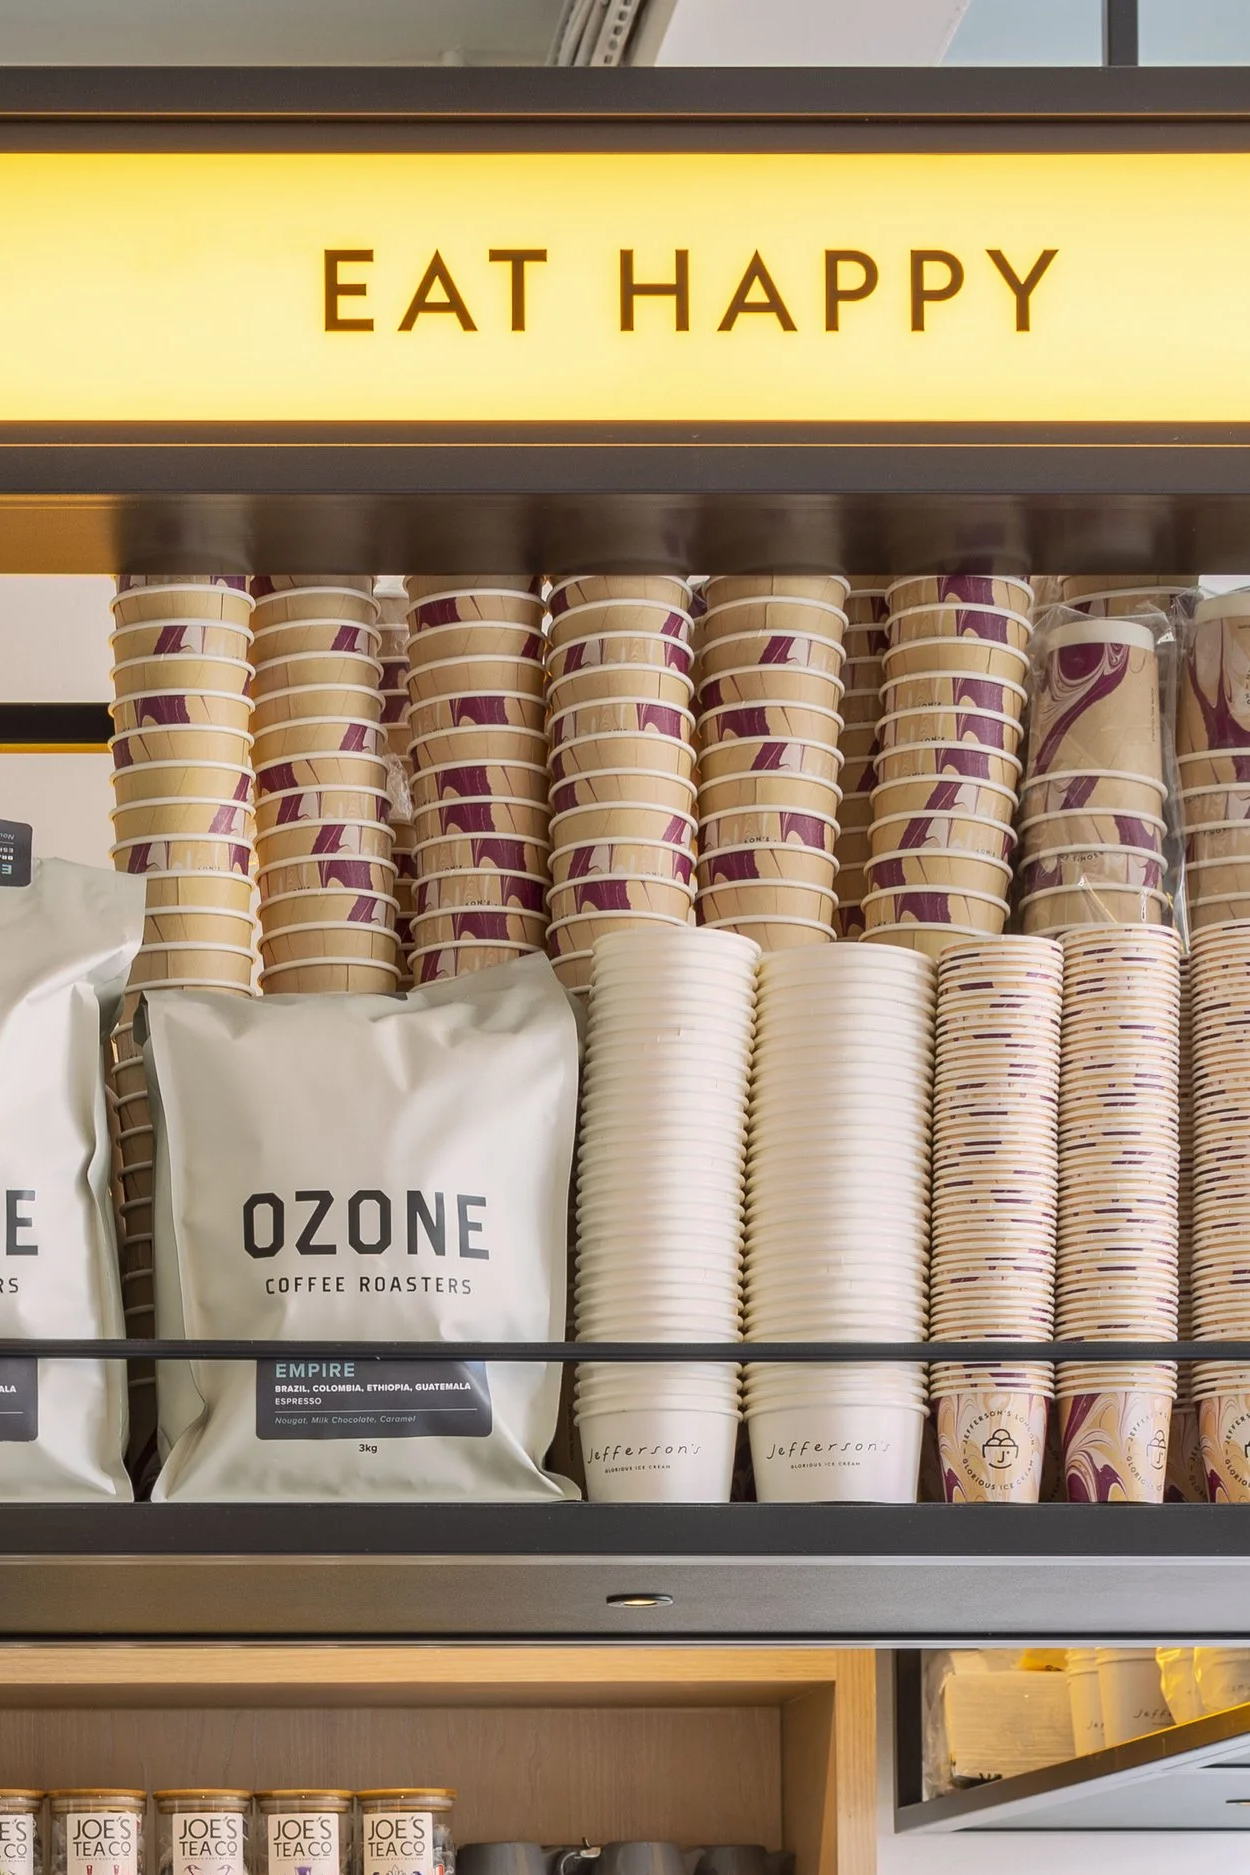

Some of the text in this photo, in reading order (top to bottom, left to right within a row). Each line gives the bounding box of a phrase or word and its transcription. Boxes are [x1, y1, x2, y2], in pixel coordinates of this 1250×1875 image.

[323, 248, 1059, 332] EAT HAPPY
[243, 1190, 490, 1260] OZONE
[265, 1276, 471, 1295] COFFEE ROASTERS
[275, 1362, 355, 1379] EMPIRE
[275, 1382, 471, 1394] BRAZIL, COLOMBIA, ETHIOPIA, GUATEMALA
[275, 1397, 322, 1406] ESPRESSO
[275, 1415, 416, 1426] Nougat, Milk Chocolate, Caramel
[963, 1410, 1011, 1444] JEFFERSON'S
[359, 1444, 378, 1454] 3kg
[587, 1443, 701, 1464] Jefferson's
[766, 1440, 890, 1460] Jefferson's
[963, 1458, 996, 1490] GLORIOUS
[73, 1816, 131, 1840] JOE'S
[179, 1815, 237, 1839] JOE'S
[274, 1816, 332, 1840] JOE'S
[368, 1816, 425, 1840] JOE'S
[73, 1841, 105, 1856] TEA
[179, 1841, 211, 1856] TEA
[274, 1842, 305, 1857] TEA
[368, 1842, 398, 1857] TEA
